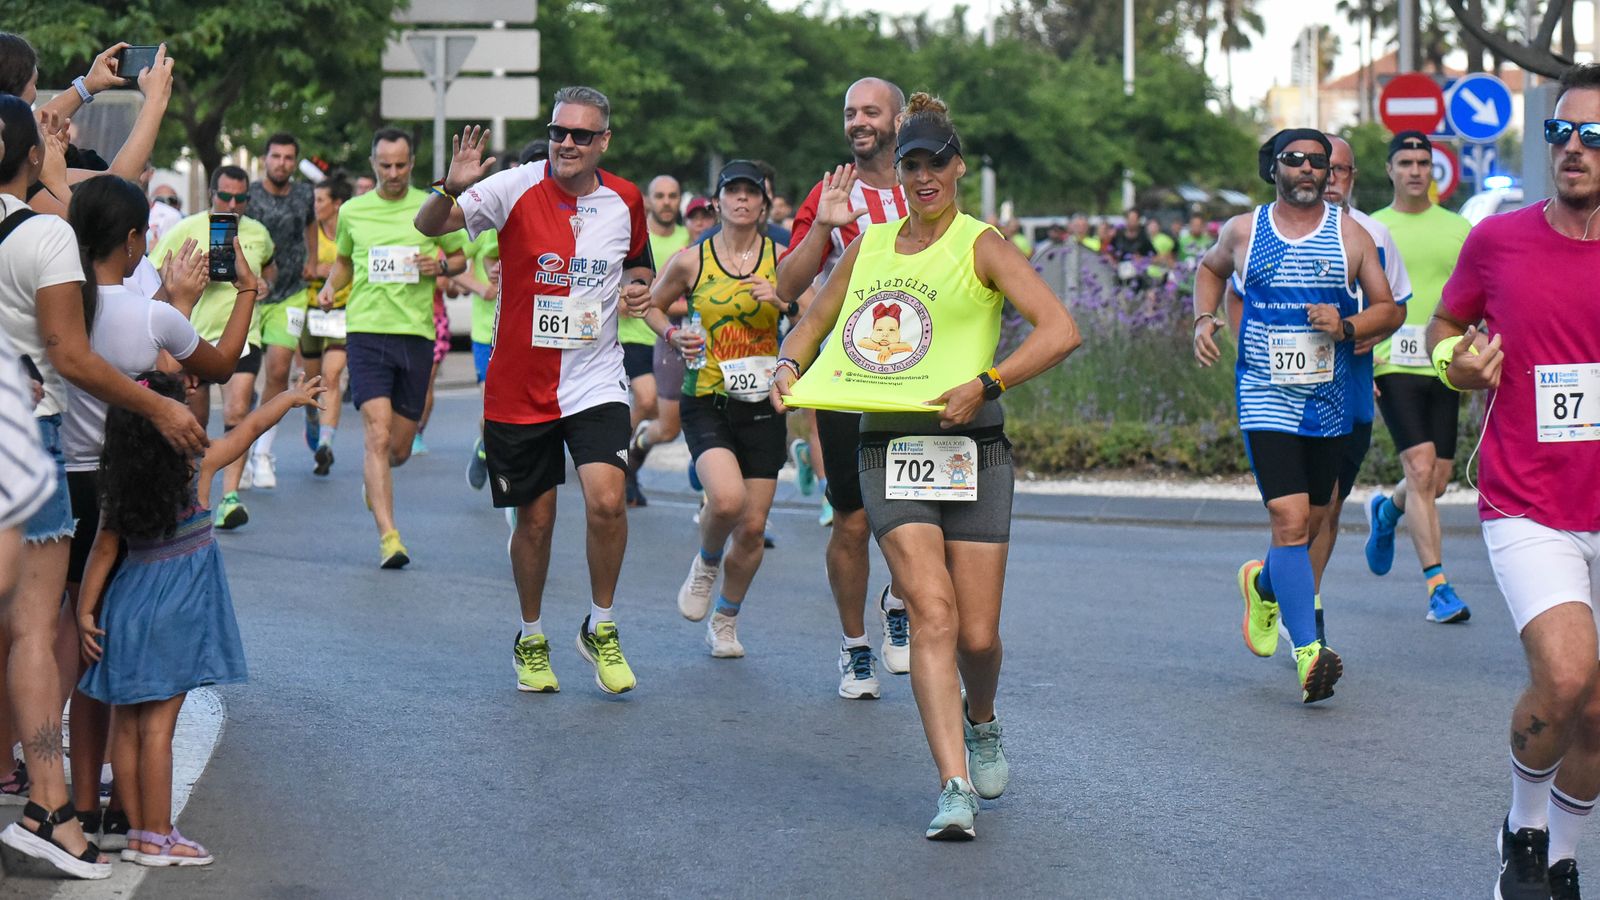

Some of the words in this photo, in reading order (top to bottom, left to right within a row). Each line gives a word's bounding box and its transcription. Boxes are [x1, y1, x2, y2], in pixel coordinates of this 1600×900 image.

[373, 259, 395, 272] 524
[569, 257, 608, 275] 威视
[538, 314, 569, 334] 661
[1400, 339, 1418, 354] 96
[878, 364, 889, 373] de
[1275, 352, 1306, 370] 370
[730, 373, 758, 391] 292
[1540, 372, 1558, 383] XXI
[1553, 392, 1584, 420] 87
[891, 442, 907, 452] XXI
[894, 459, 935, 482] 702
